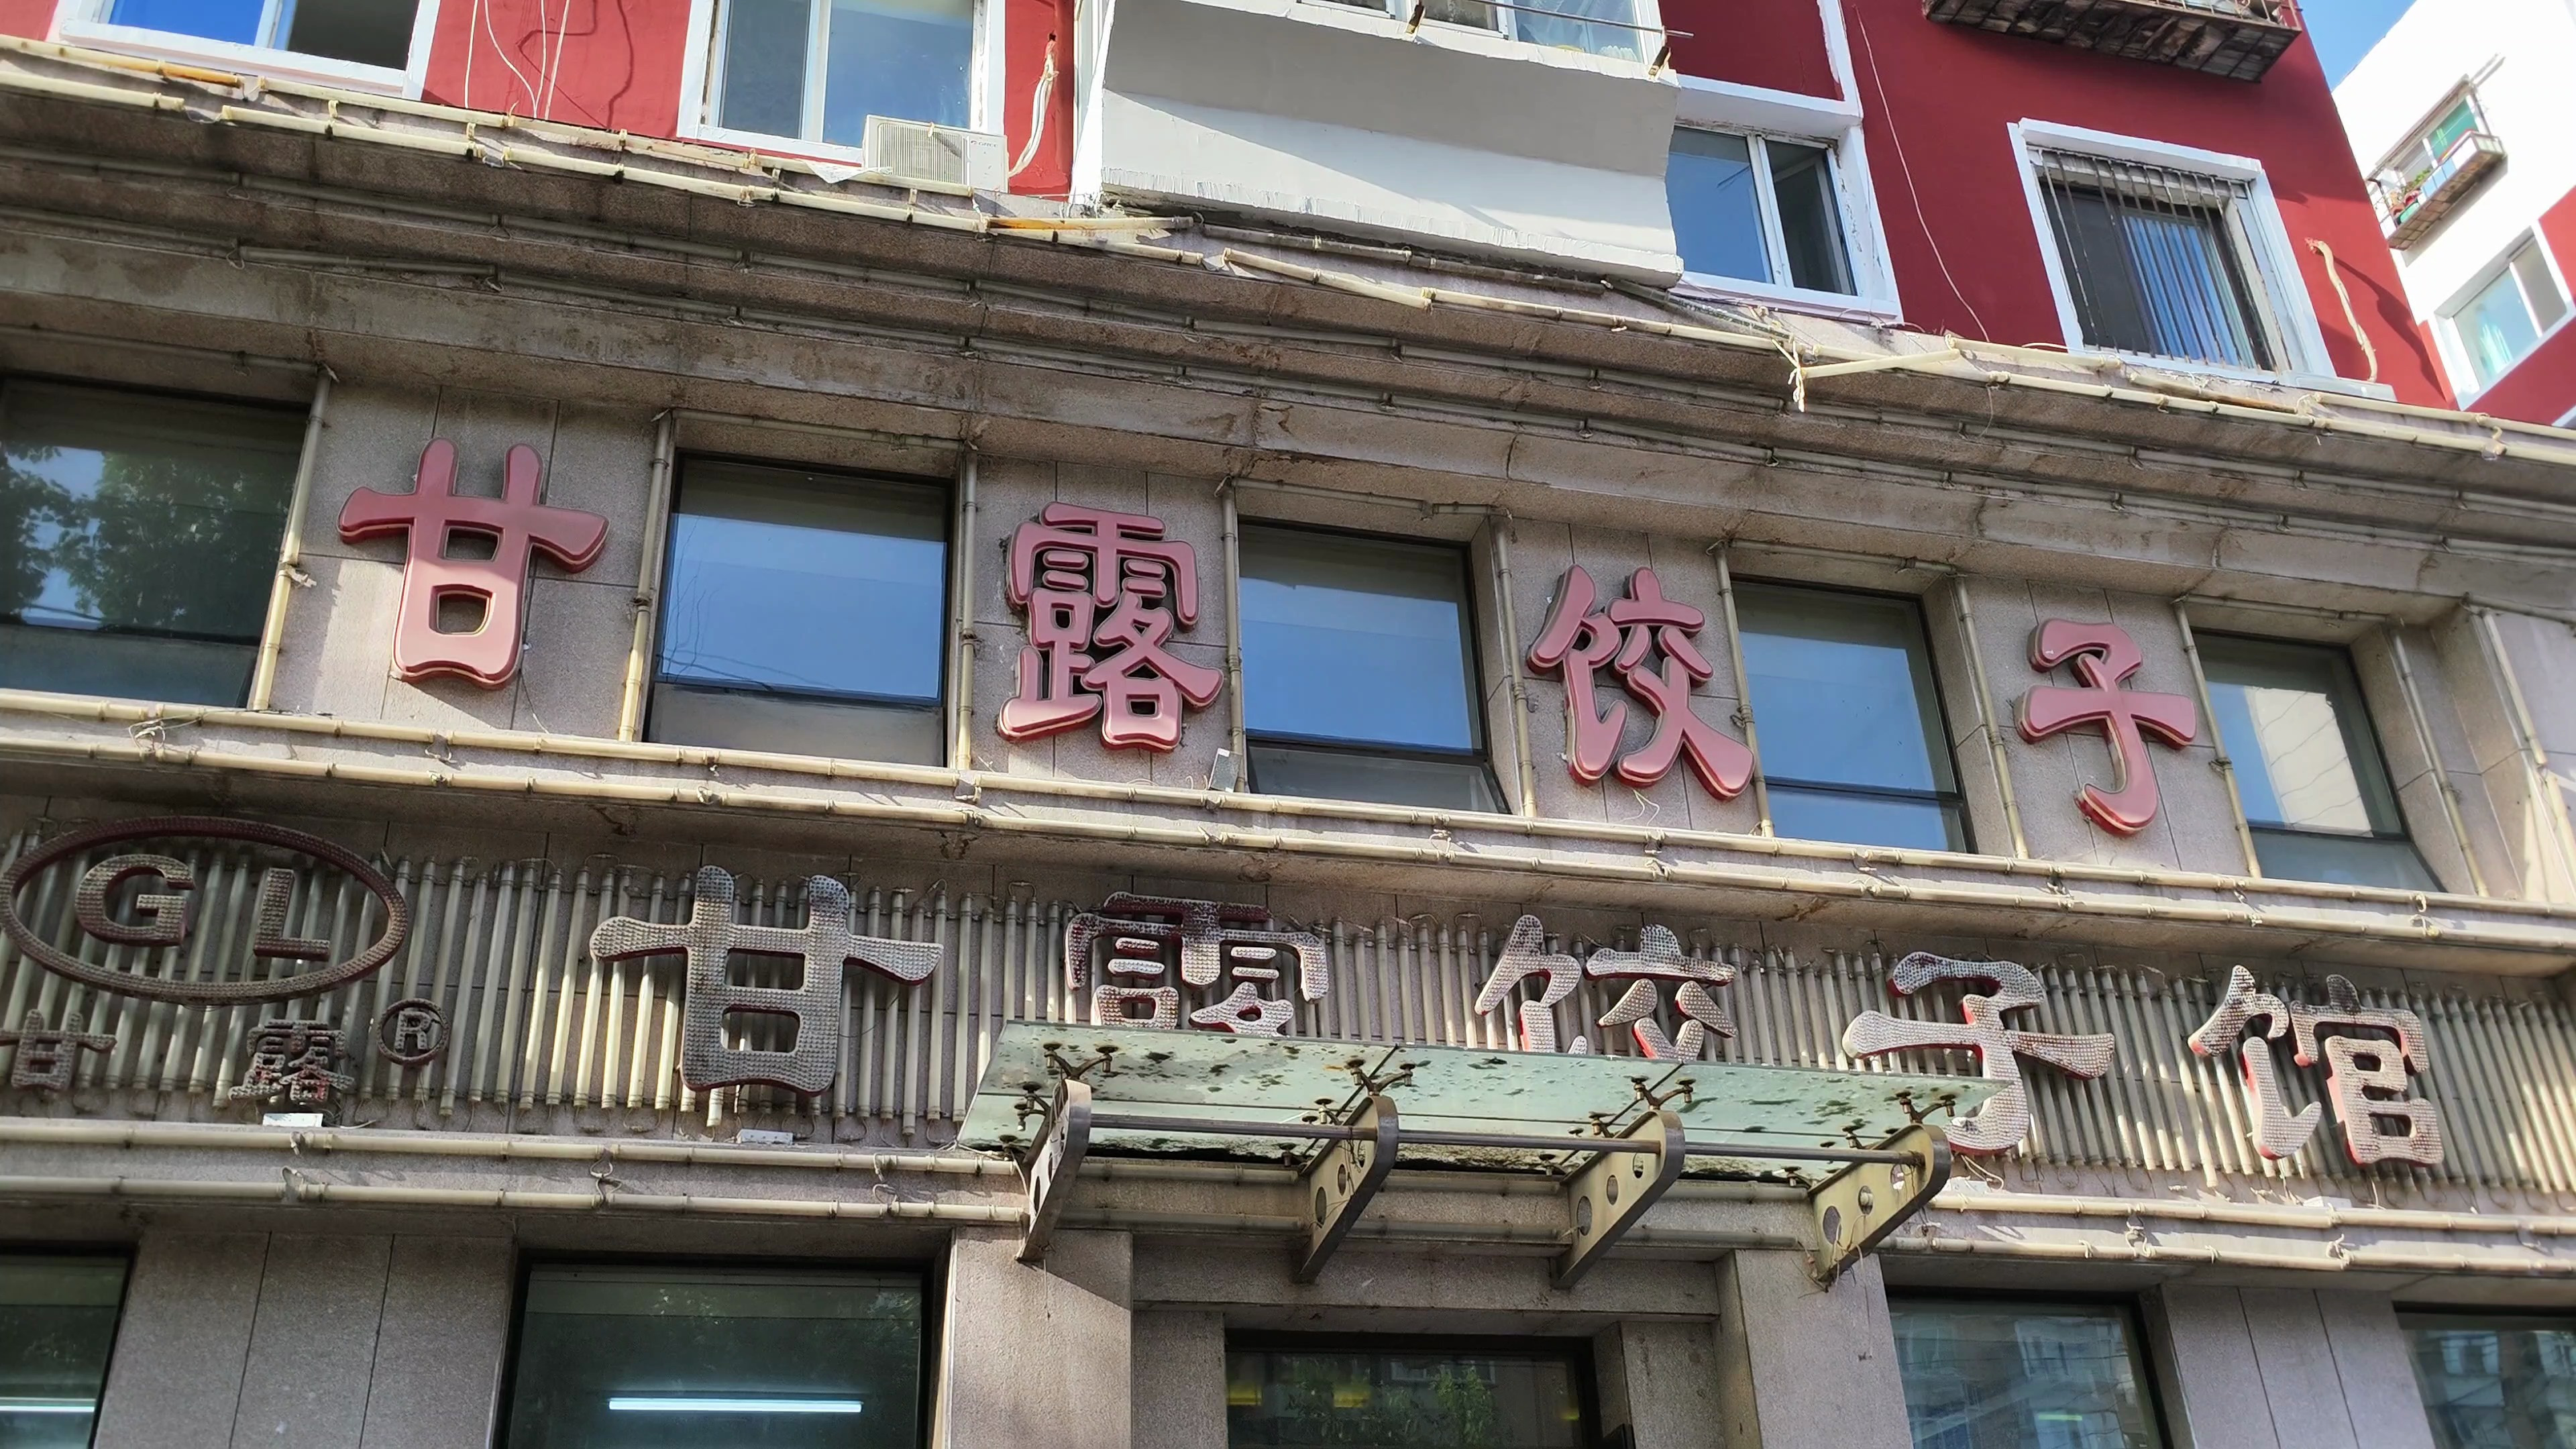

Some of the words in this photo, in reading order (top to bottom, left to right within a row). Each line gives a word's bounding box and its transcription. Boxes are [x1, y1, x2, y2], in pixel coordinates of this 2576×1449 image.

[337, 437, 2198, 838] 甘露饺子
[74, 853, 331, 961] GL
[0, 1008, 356, 1106] 甘露
